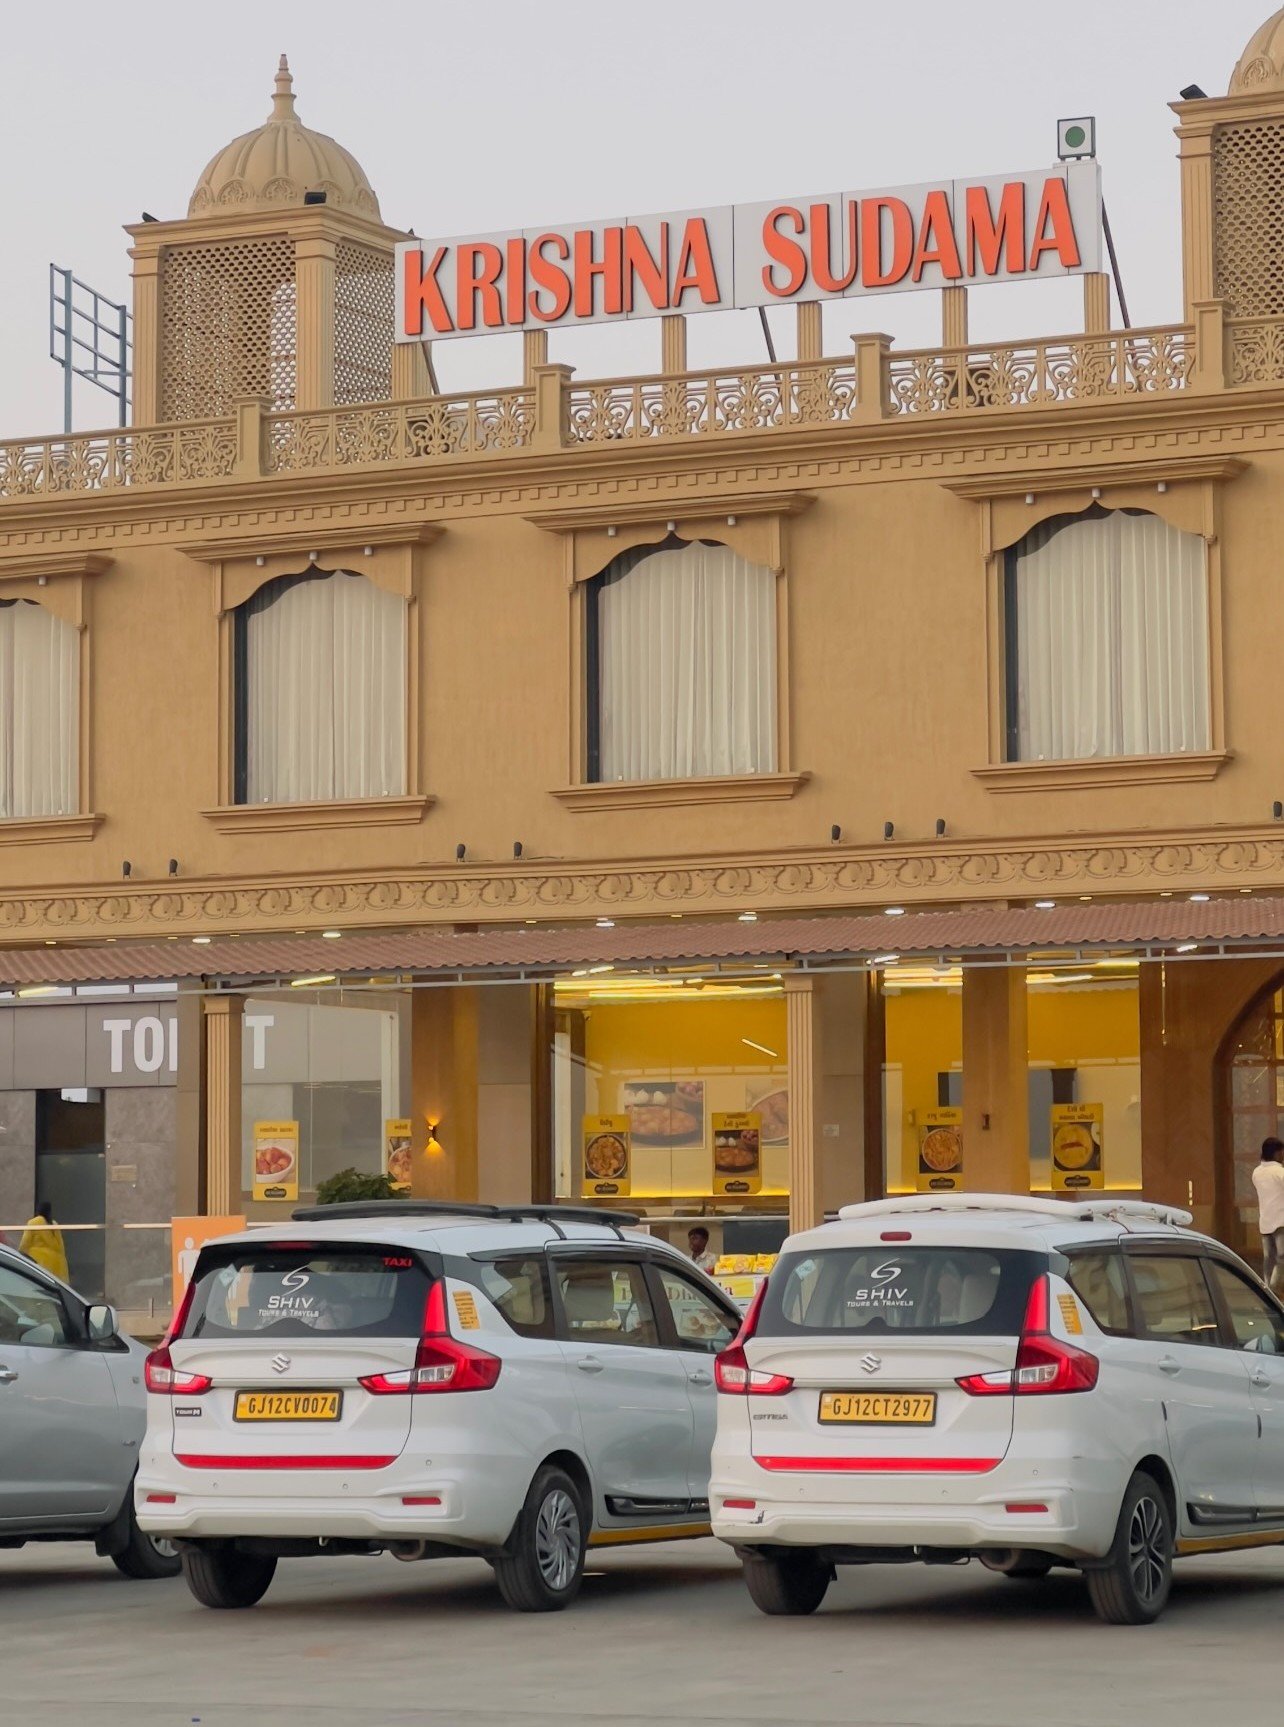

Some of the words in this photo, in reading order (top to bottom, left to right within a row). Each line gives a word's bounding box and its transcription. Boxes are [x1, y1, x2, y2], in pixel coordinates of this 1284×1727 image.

[404, 217, 720, 336] KRISHNA
[761, 177, 1081, 297] SUDAMA
[383, 1257, 413, 1267] TAXI
[267, 1295, 314, 1309] SHIV
[855, 1288, 908, 1300] SHIV
[248, 1396, 337, 1415] GJ12CV0074
[833, 1398, 932, 1417] GJ12CT2977
